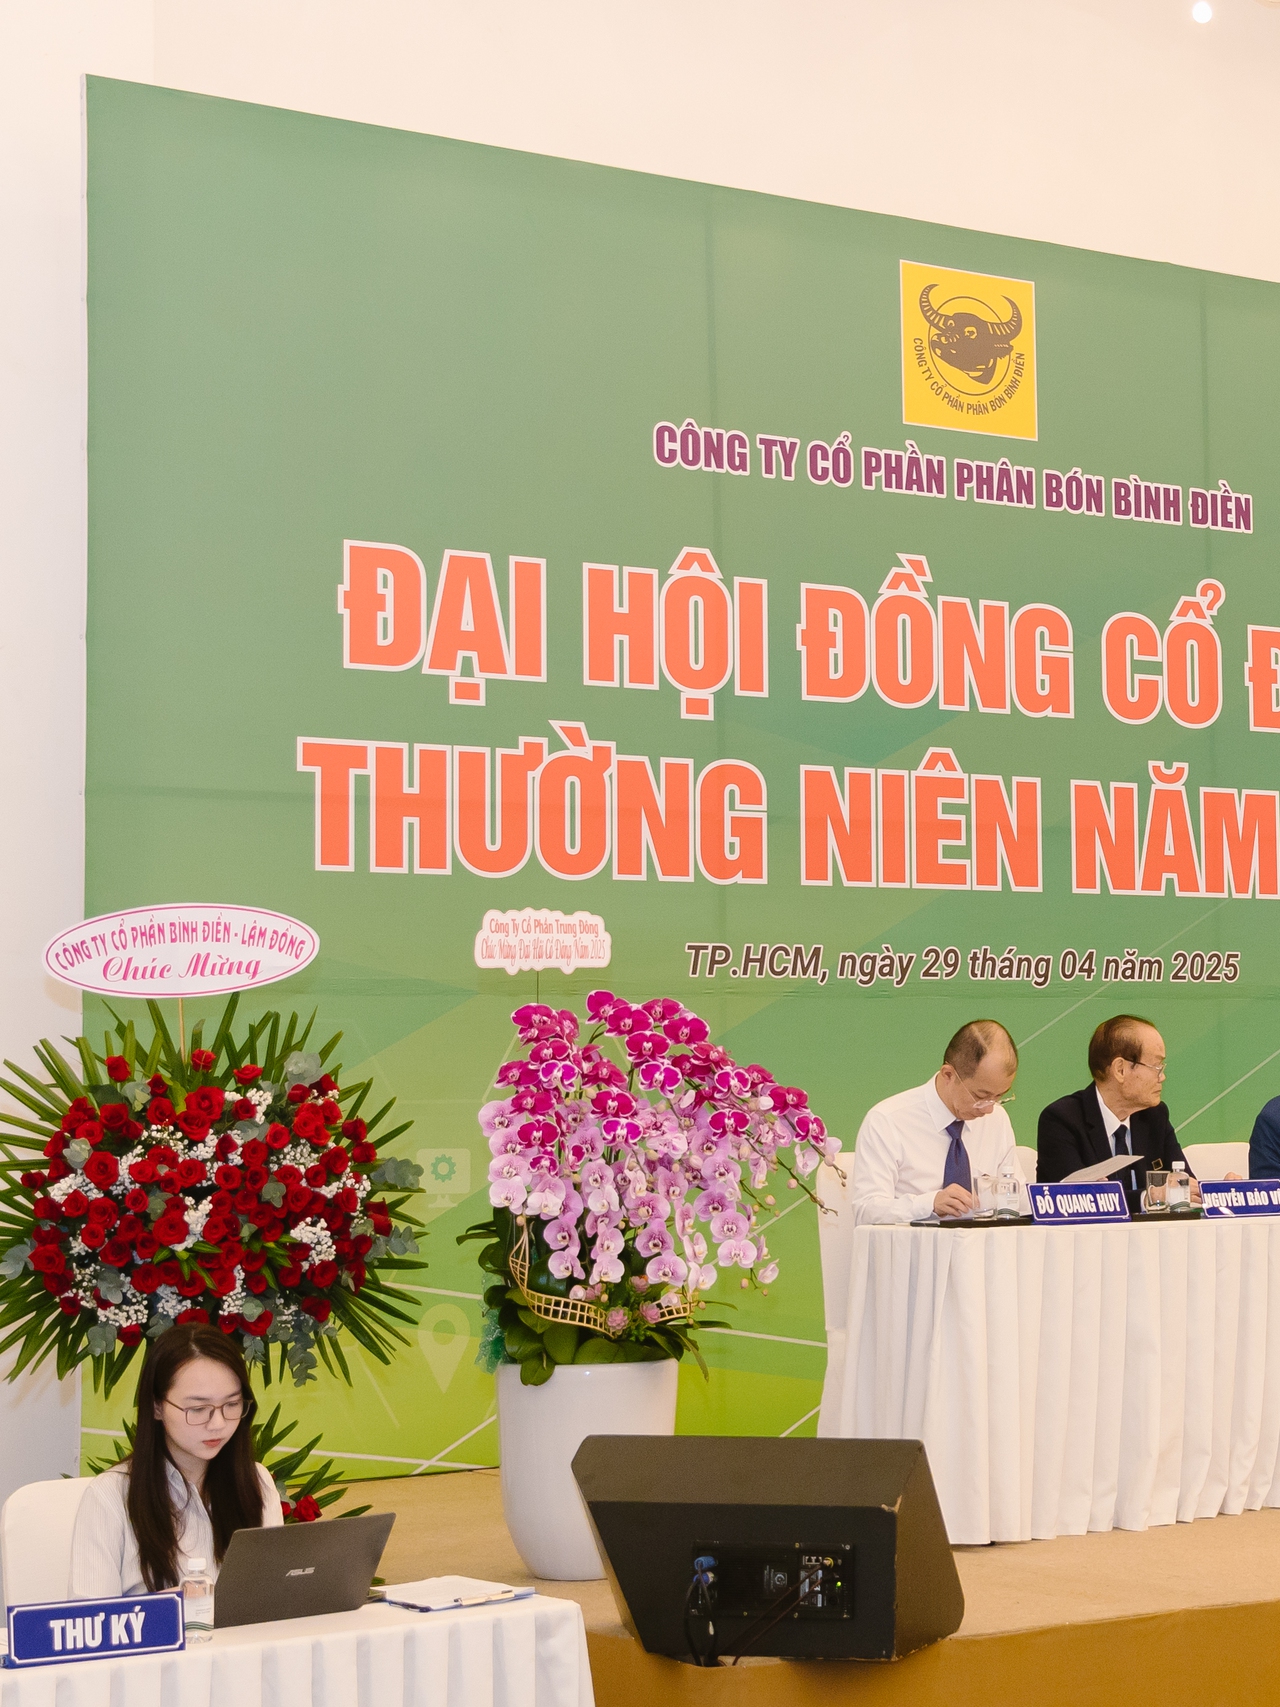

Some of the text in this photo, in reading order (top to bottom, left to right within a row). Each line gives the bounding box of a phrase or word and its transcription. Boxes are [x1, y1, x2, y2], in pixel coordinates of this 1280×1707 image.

[914, 338, 927, 367] CÔNG
[921, 366, 934, 381] TY
[930, 381, 947, 396] CỔ
[942, 391, 964, 413] PHẦN
[967, 401, 989, 415] PHÂN
[989, 395, 1007, 411] BÓN
[1003, 376, 1021, 400] BÌNH
[653, 418, 1254, 534] CÔNG TY CỔ PHẦN PHÂN BÓN BÌNH ĐIỀN
[338, 539, 547, 706] ĐẠI
[582, 546, 768, 721] HỘI
[796, 553, 1075, 719] ĐỒNG
[1101, 578, 1223, 729] CỔ
[297, 719, 768, 885] THƯỜNG
[800, 746, 1043, 893] NIÊN
[54, 942, 93, 971] CÔNG
[91, 932, 108, 957] TY
[110, 918, 128, 951] CỔ
[130, 914, 166, 948] PHẦN
[169, 915, 199, 945] BÌNH
[202, 912, 231, 943] ĐIỀN
[241, 920, 267, 948] LÂM
[270, 924, 306, 960] ĐỒNG
[489, 916, 599, 937] Công Ty Cổ Phần Trung Đông
[102, 952, 263, 982] Chúc Mừng
[685, 942, 1240, 989] TP.HCM, ngày 29 tháng 04 năm 2025
[1035, 1186, 1121, 1217] ĐỖ QUANG HUY
[1203, 1188, 1246, 1208] NGUYỄN
[1248, 1188, 1270, 1206] BẢO
[286, 1567, 315, 1577] ASUS
[49, 1605, 147, 1650] THƯ KÝ
